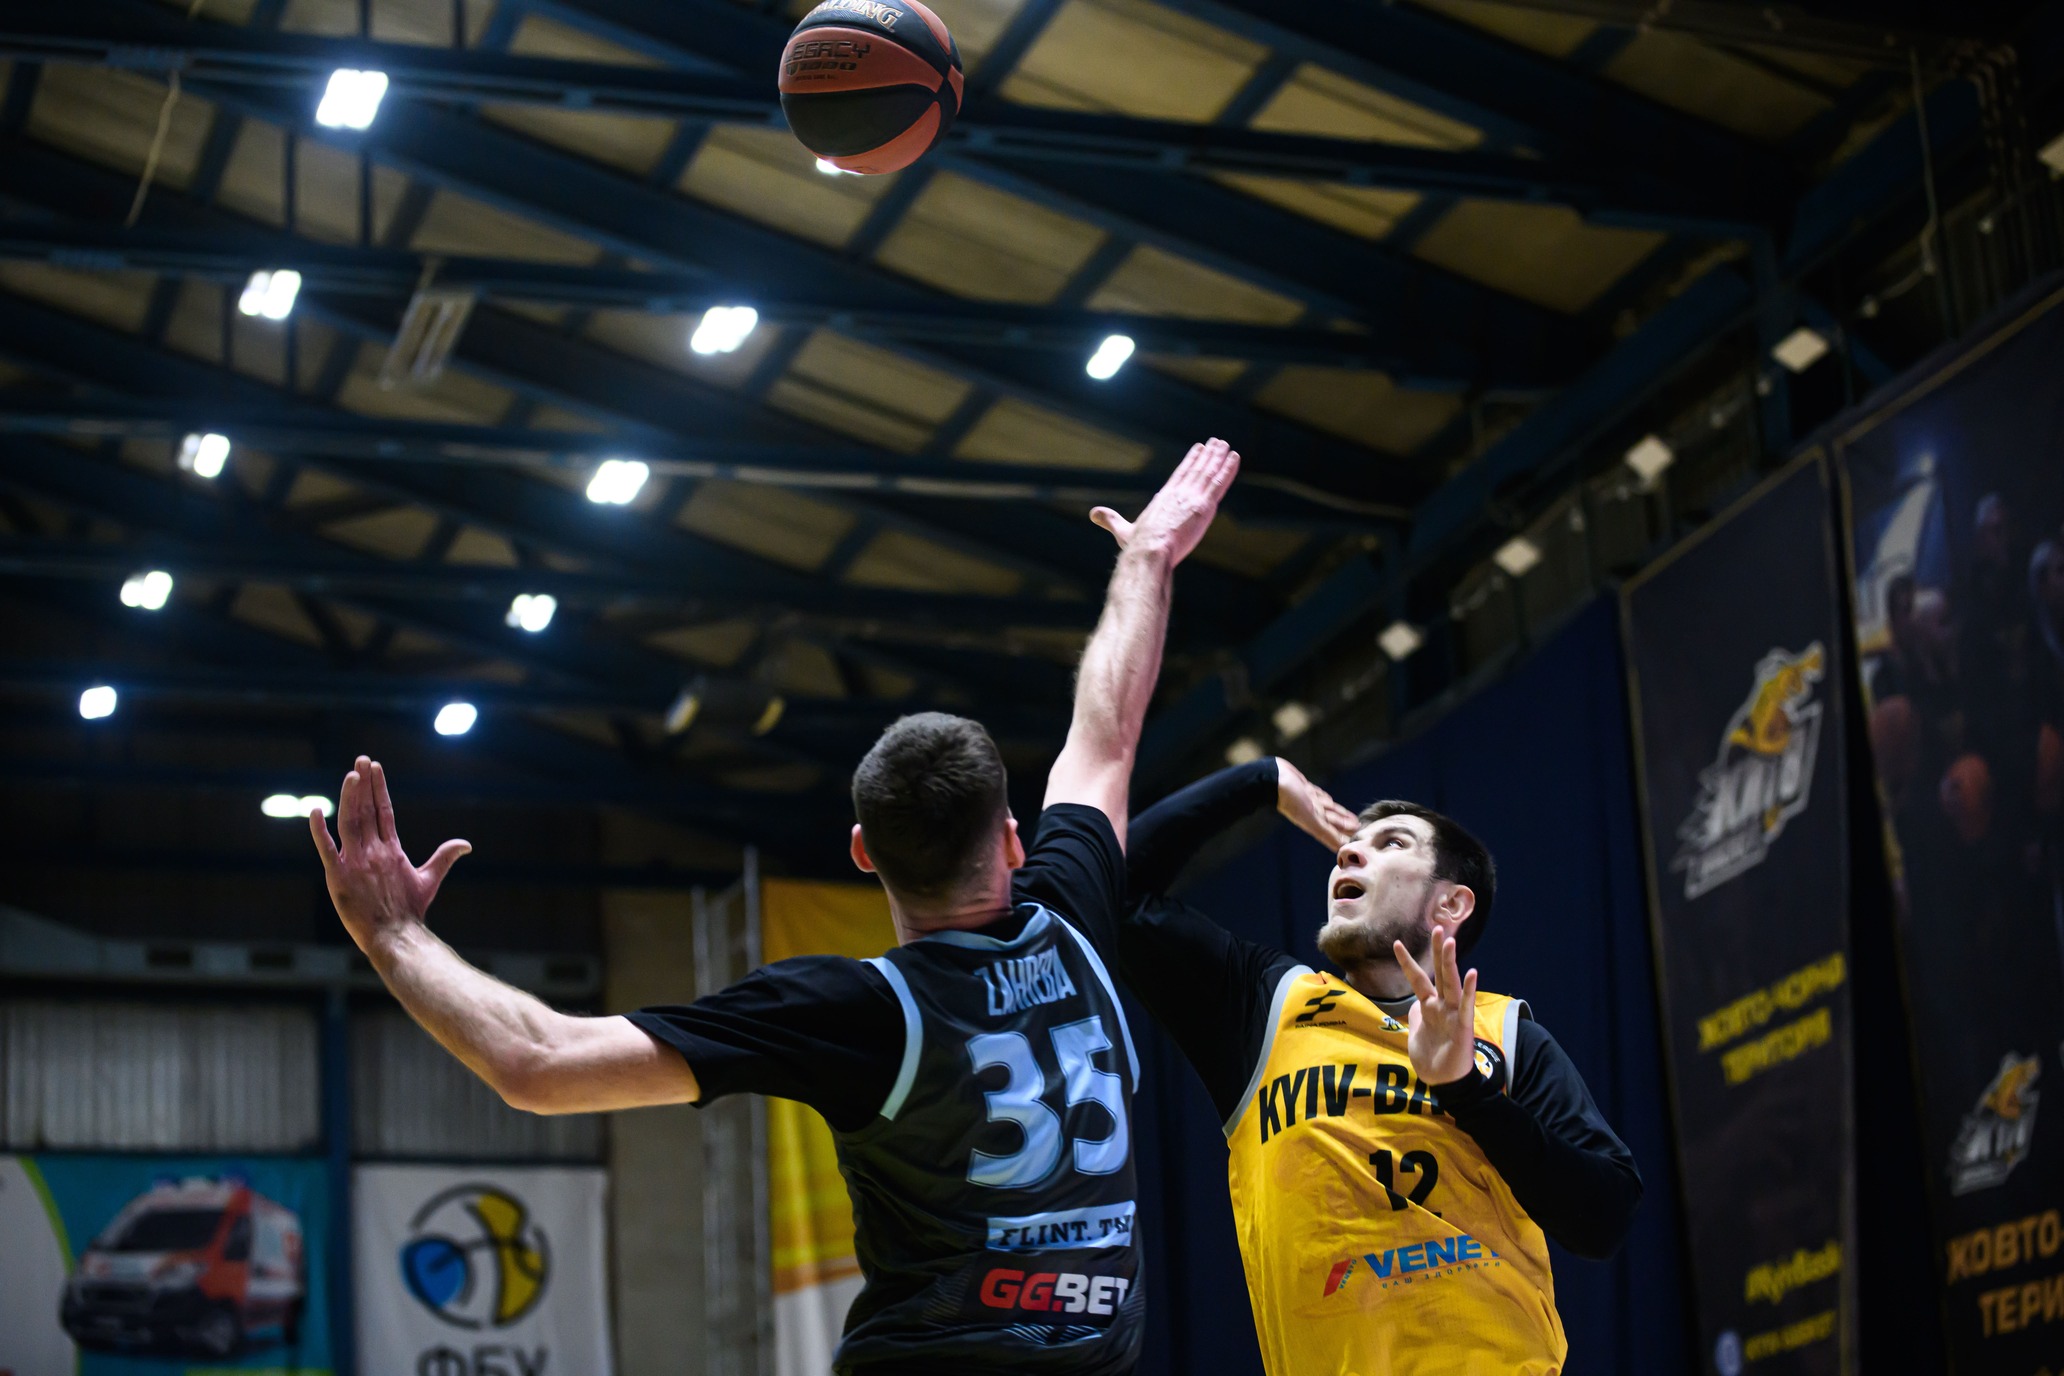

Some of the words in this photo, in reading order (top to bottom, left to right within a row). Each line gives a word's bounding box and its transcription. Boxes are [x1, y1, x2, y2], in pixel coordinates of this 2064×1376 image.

[965, 1014, 1131, 1190] 35
[1369, 1150, 1442, 1218] 12
[1363, 1234, 1500, 1279] VENE
